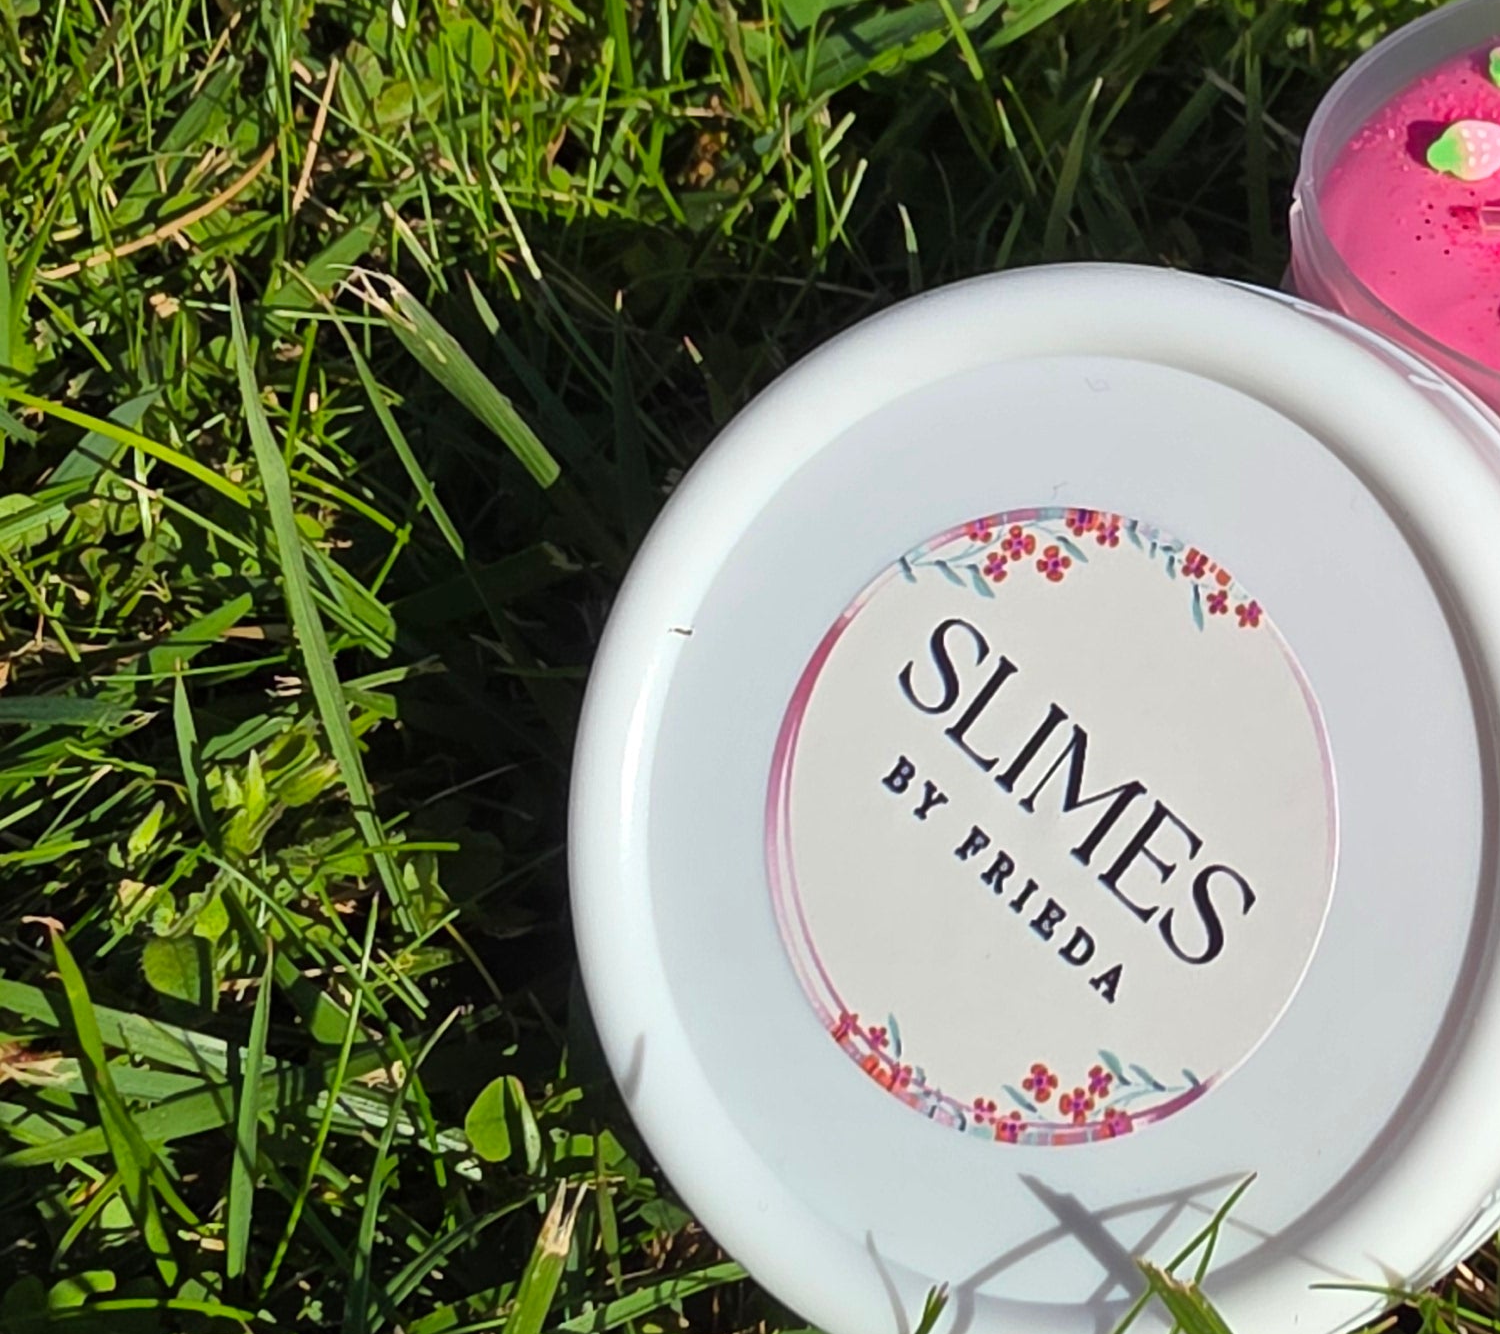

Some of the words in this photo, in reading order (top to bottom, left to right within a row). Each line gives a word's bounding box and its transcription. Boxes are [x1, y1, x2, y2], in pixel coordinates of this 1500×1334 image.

[881, 755, 949, 820] BY
[953, 825, 1125, 1003] FRIEDA
[898, 618, 1256, 965] SLIMES
